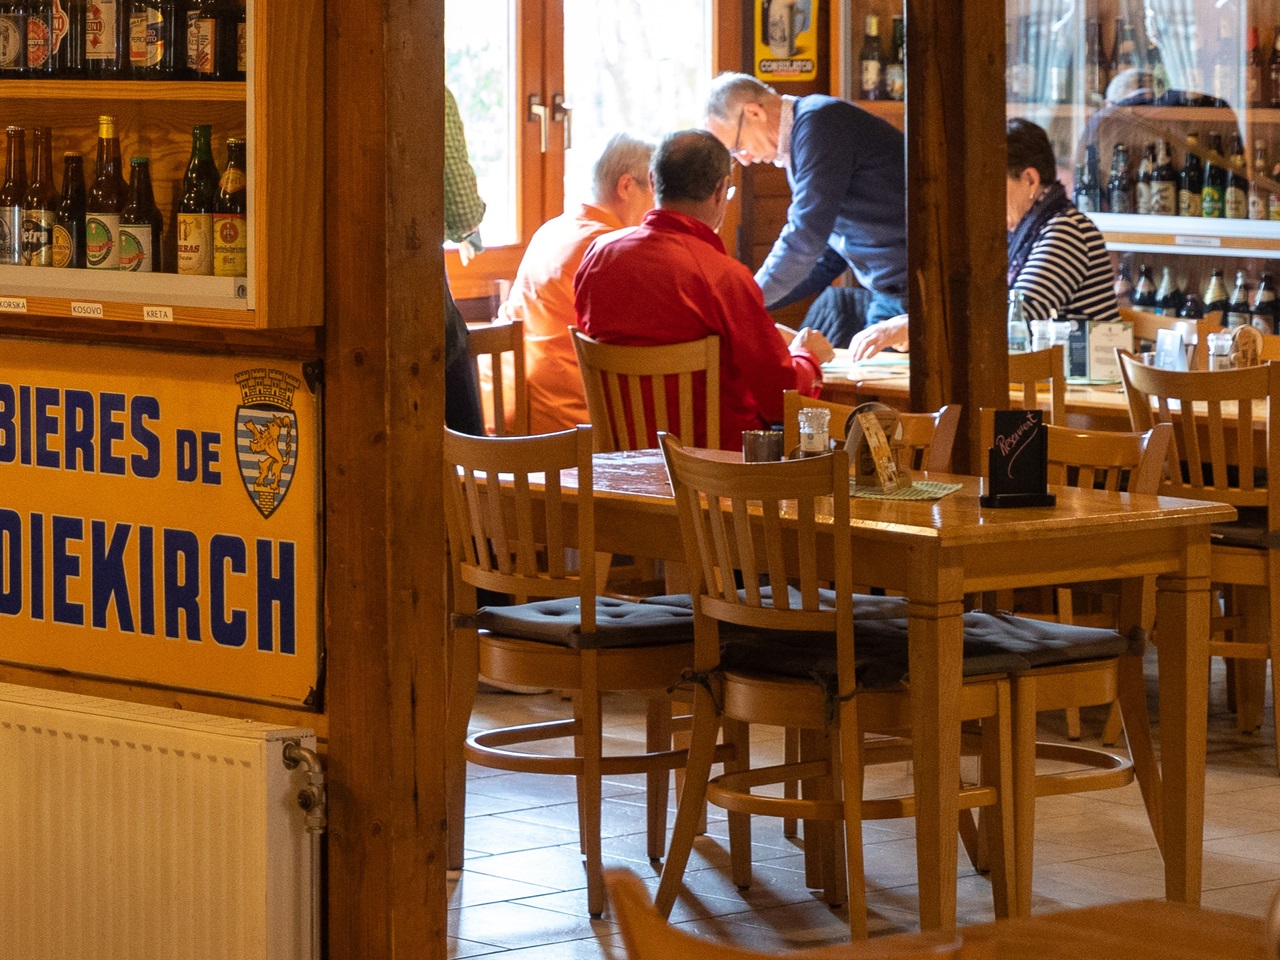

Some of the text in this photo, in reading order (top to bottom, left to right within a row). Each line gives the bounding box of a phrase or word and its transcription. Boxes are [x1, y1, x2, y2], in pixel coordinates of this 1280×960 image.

[72, 304, 102, 316] KOSOVO
[146, 309, 169, 319] KRETA
[176, 428, 223, 486] DE
